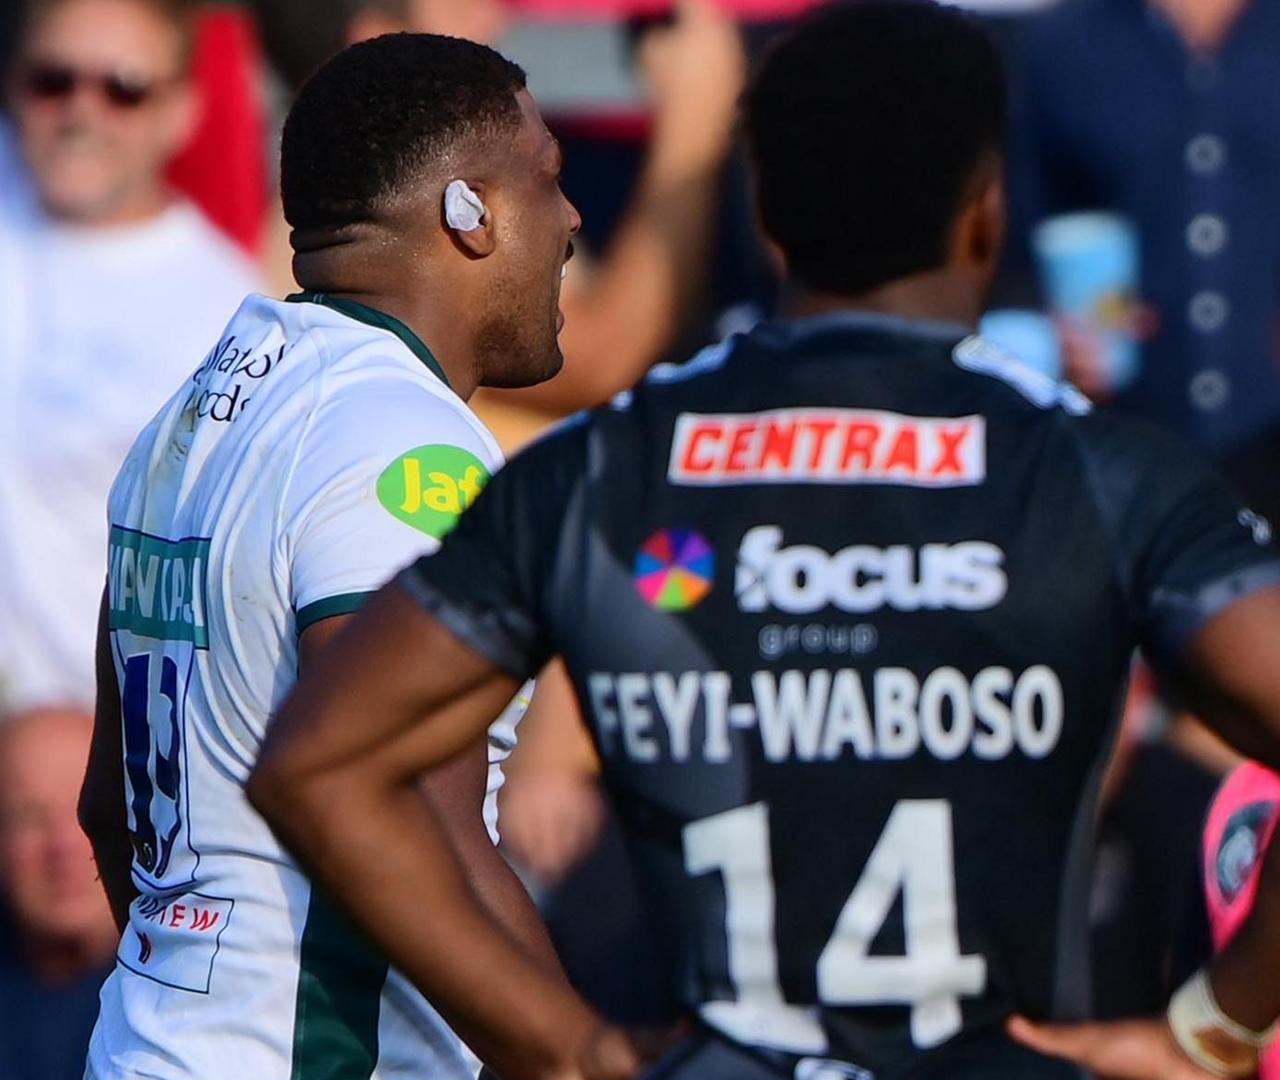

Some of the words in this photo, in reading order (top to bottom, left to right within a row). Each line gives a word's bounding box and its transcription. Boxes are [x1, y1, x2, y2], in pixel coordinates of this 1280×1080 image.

[682, 417, 971, 474] CENTRAX
[734, 524, 1008, 614] focus
[759, 624, 879, 660] group
[587, 663, 1064, 763] FEYI-WABOSO
[680, 798, 988, 1054] 14
